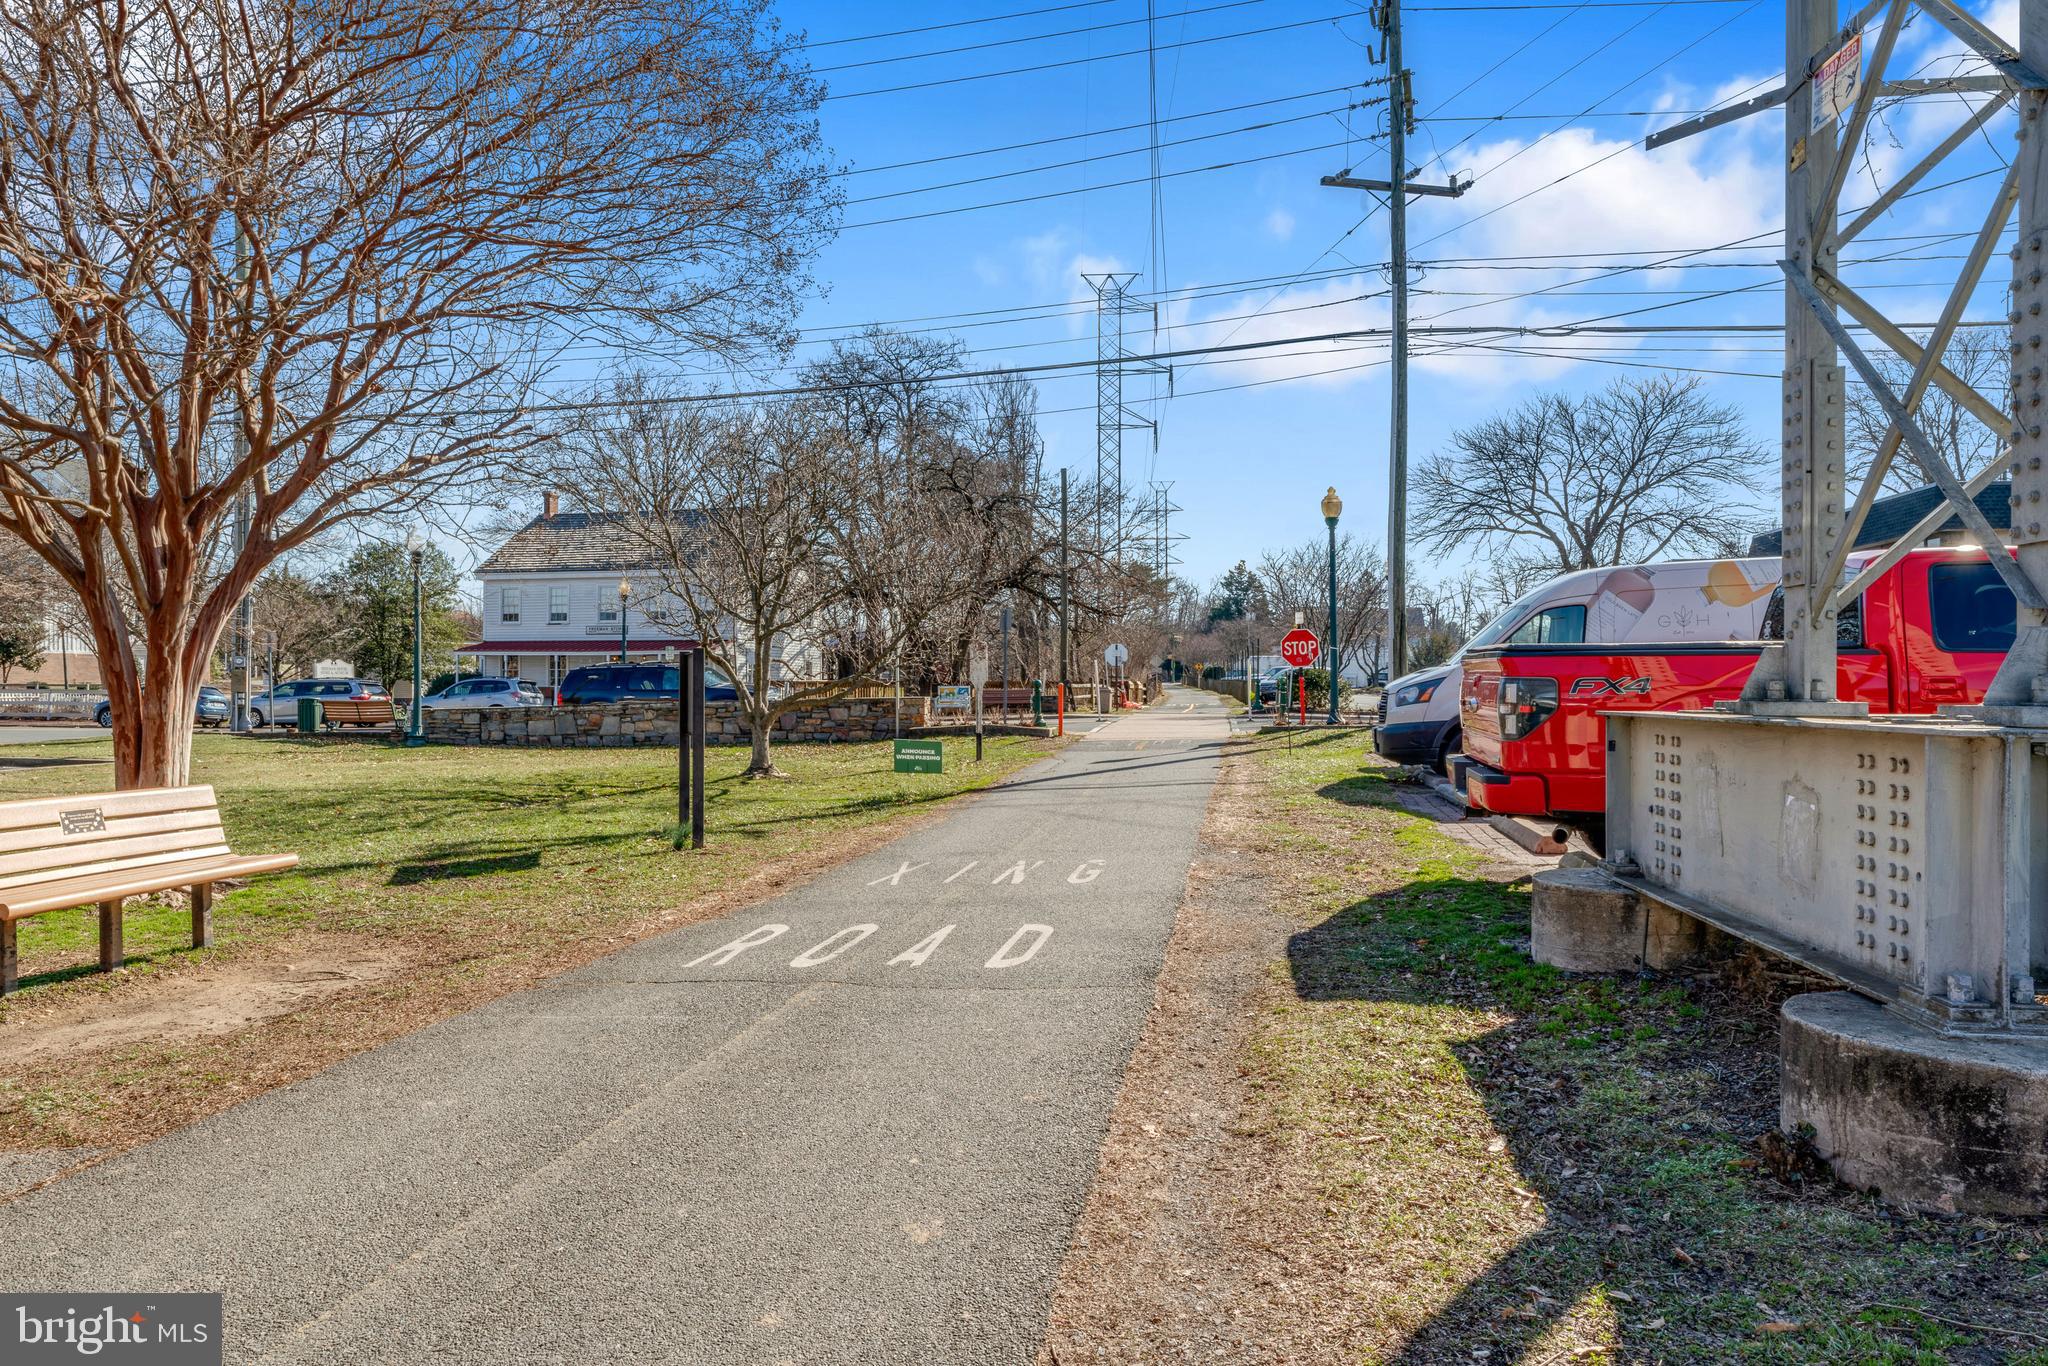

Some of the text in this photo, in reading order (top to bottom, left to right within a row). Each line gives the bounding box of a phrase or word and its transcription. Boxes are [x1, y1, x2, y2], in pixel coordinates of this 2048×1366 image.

[1823, 43, 1858, 80] DANGER
[1283, 641, 1317, 656] STOP
[1568, 676, 1652, 695] FX4
[867, 859, 1106, 886] XING
[682, 923, 1055, 968] ROAD
